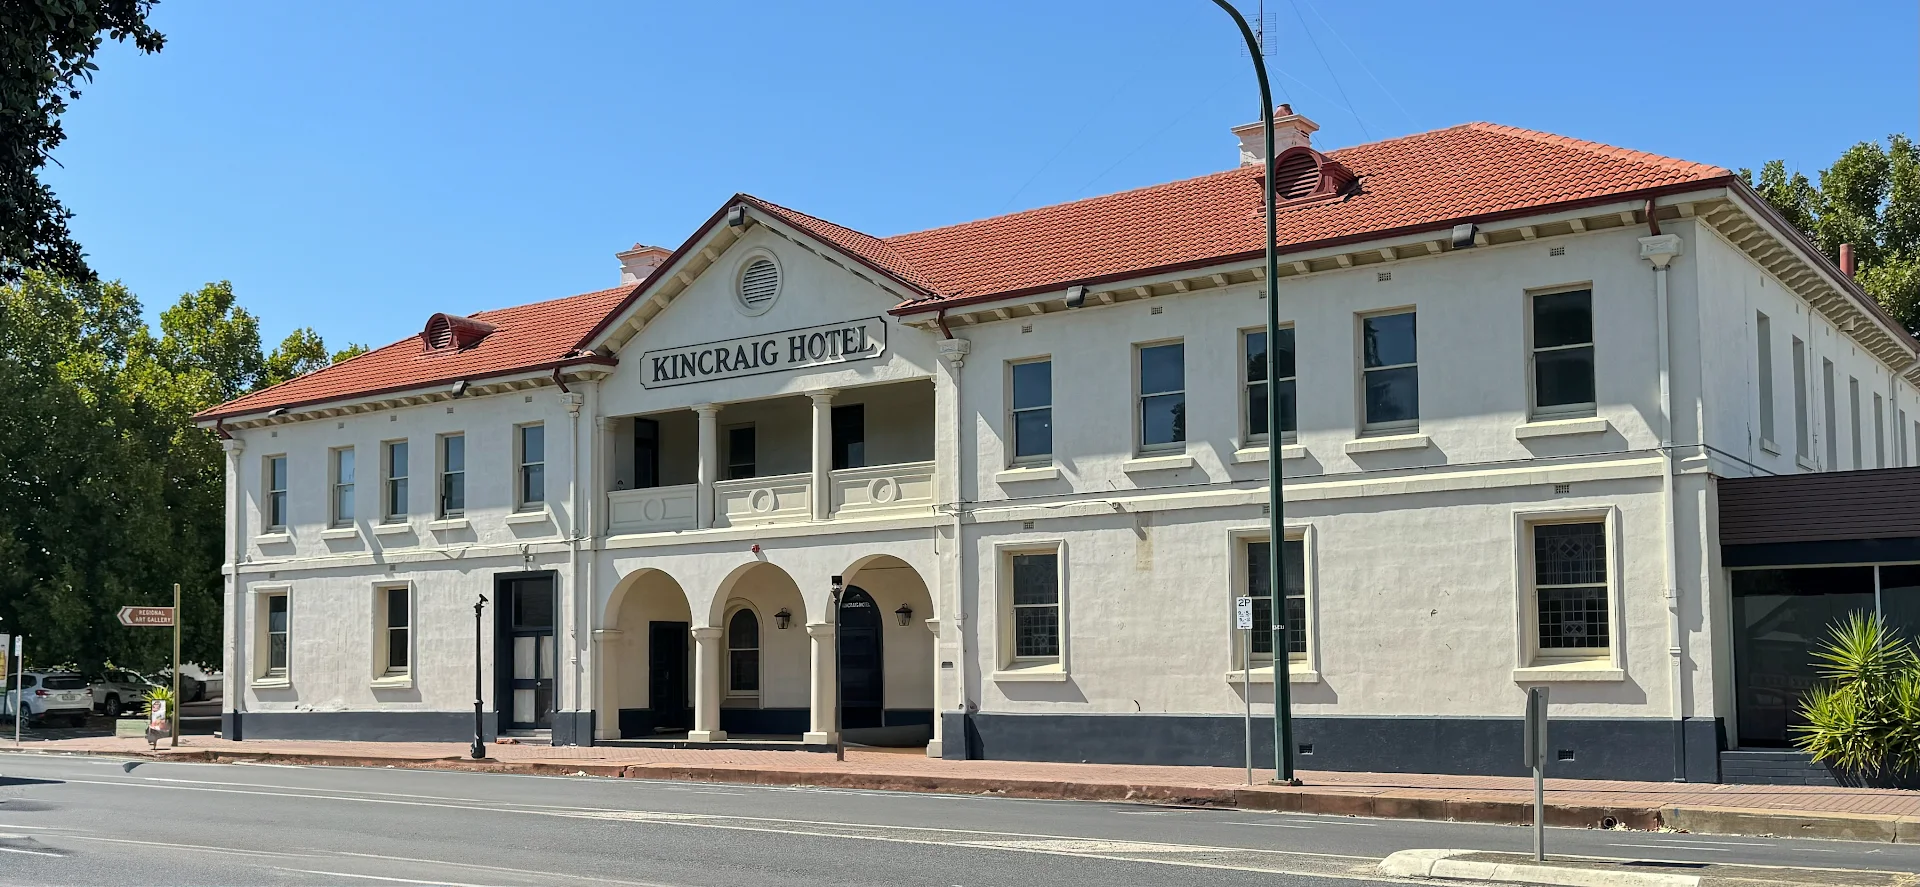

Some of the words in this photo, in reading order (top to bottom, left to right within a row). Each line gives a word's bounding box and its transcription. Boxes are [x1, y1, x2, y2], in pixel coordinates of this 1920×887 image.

[652, 340, 778, 381] KINCRAIG
[788, 326, 875, 362] HOTEL
[1238, 599, 1251, 607] 2P
